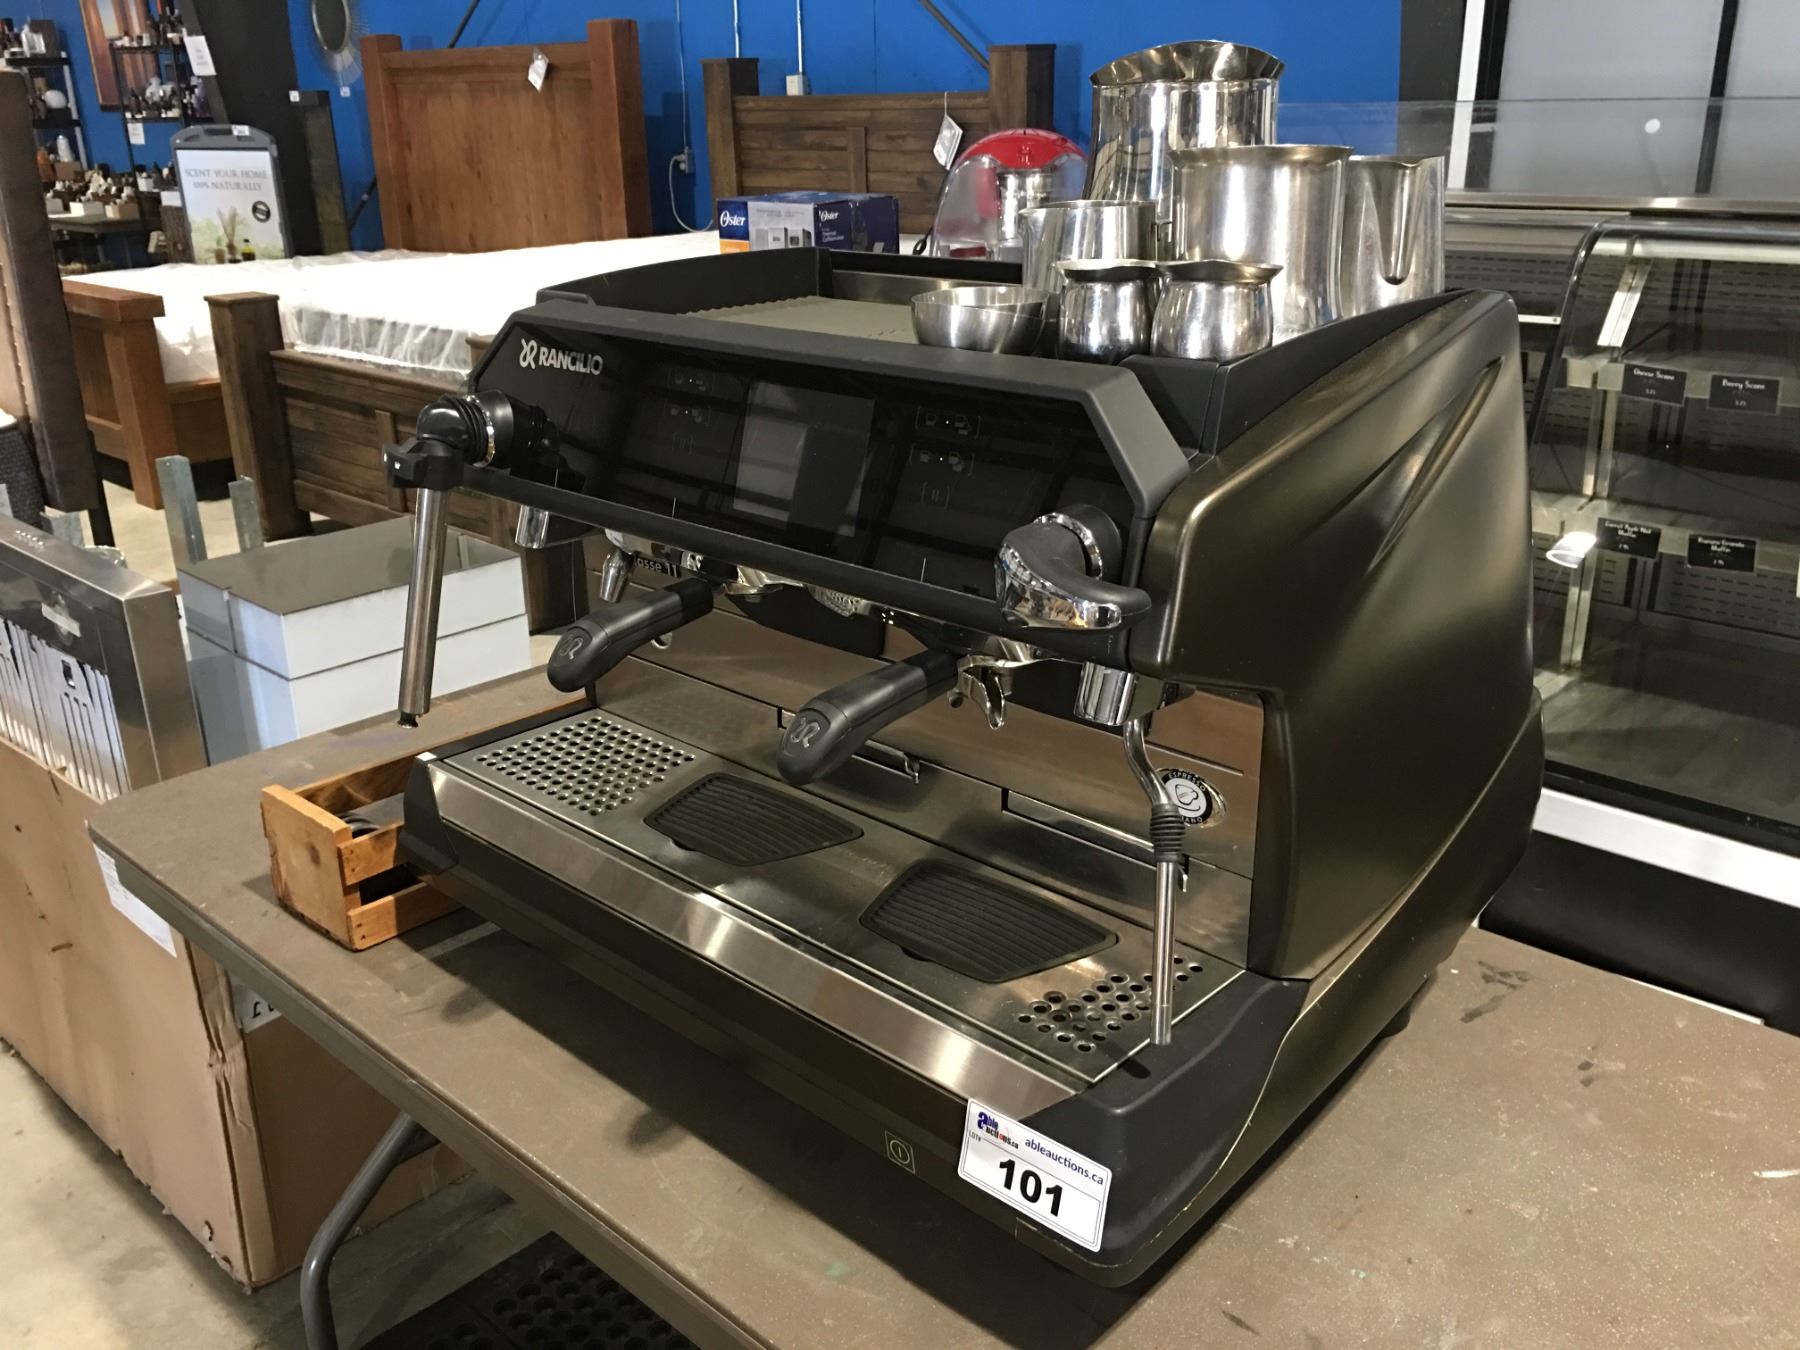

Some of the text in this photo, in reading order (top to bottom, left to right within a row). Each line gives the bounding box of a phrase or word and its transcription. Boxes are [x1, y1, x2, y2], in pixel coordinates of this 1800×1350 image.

[185, 169, 268, 179] SCENT YOUR HOME
[211, 182, 263, 191] NATURALLY
[720, 210, 746, 227] Oster
[820, 210, 839, 222] Oster
[539, 346, 603, 375] RANCILIO
[634, 558, 678, 577] asse 11
[1168, 771, 1206, 792] ESPRESSO
[968, 1130, 982, 1142] LOT#
[1025, 1138, 1104, 1185] ableauctions.ca
[1000, 1158, 1063, 1217] 101
